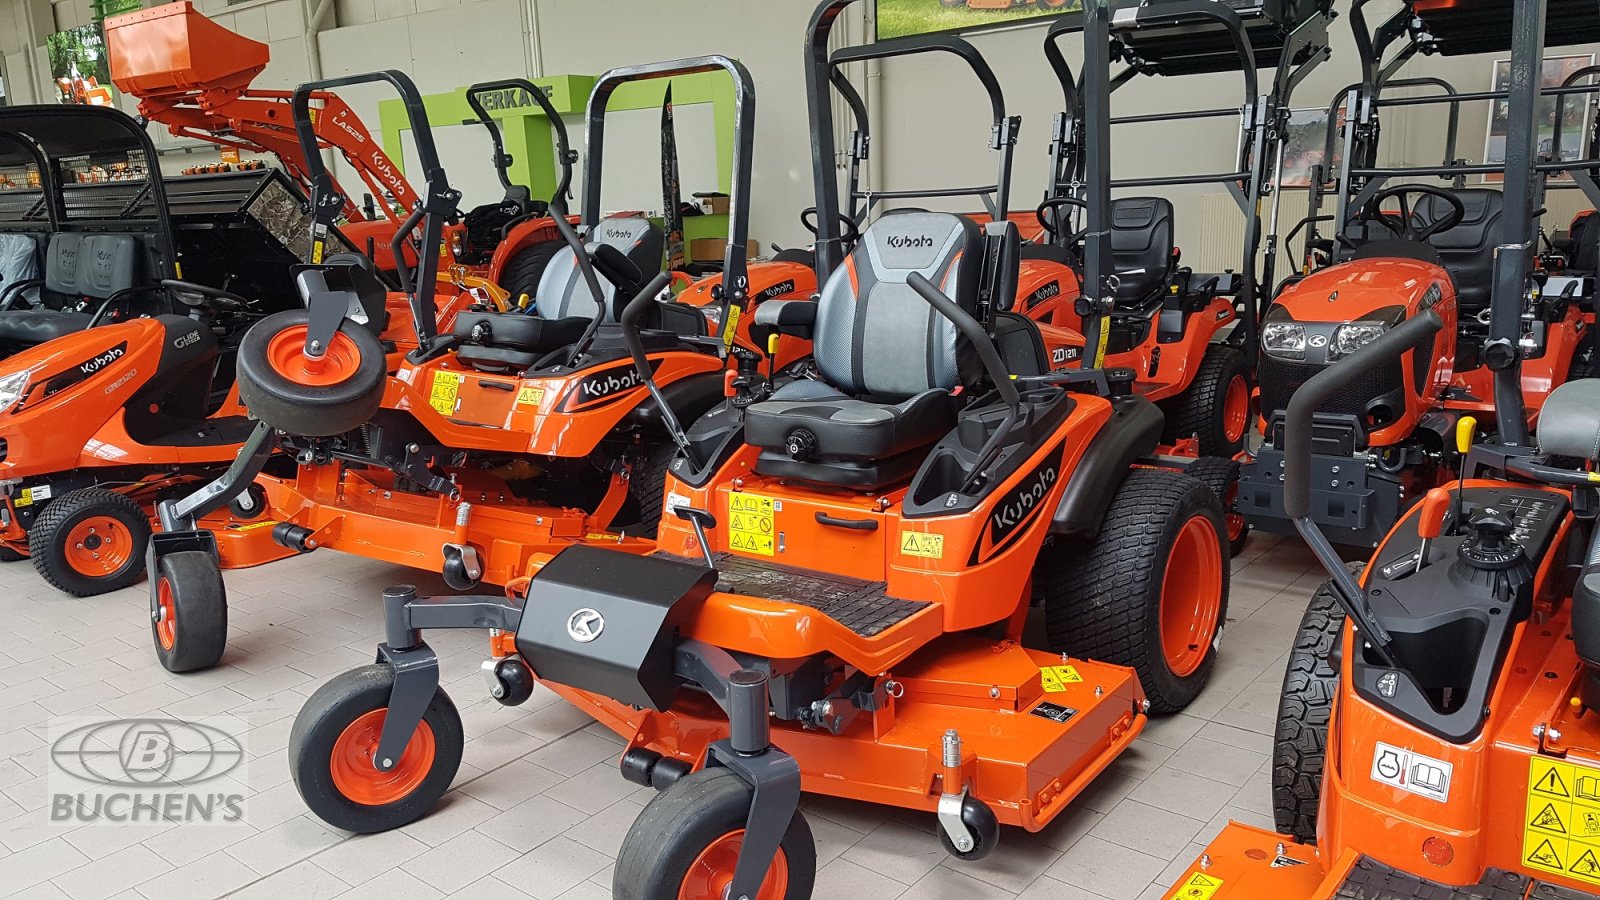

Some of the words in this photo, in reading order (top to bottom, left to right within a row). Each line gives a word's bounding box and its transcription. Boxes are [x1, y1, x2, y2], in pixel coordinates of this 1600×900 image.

[332, 116, 366, 143] LA525
[371, 151, 405, 195] Kubota
[606, 229, 632, 239] Kubota
[887, 234, 933, 248] Kubota
[765, 283, 792, 297] Kubota
[1035, 284, 1058, 300] Kubota
[80, 348, 124, 374] Kubota
[105, 368, 137, 395] GR2120
[994, 467, 1056, 529] Kubota
